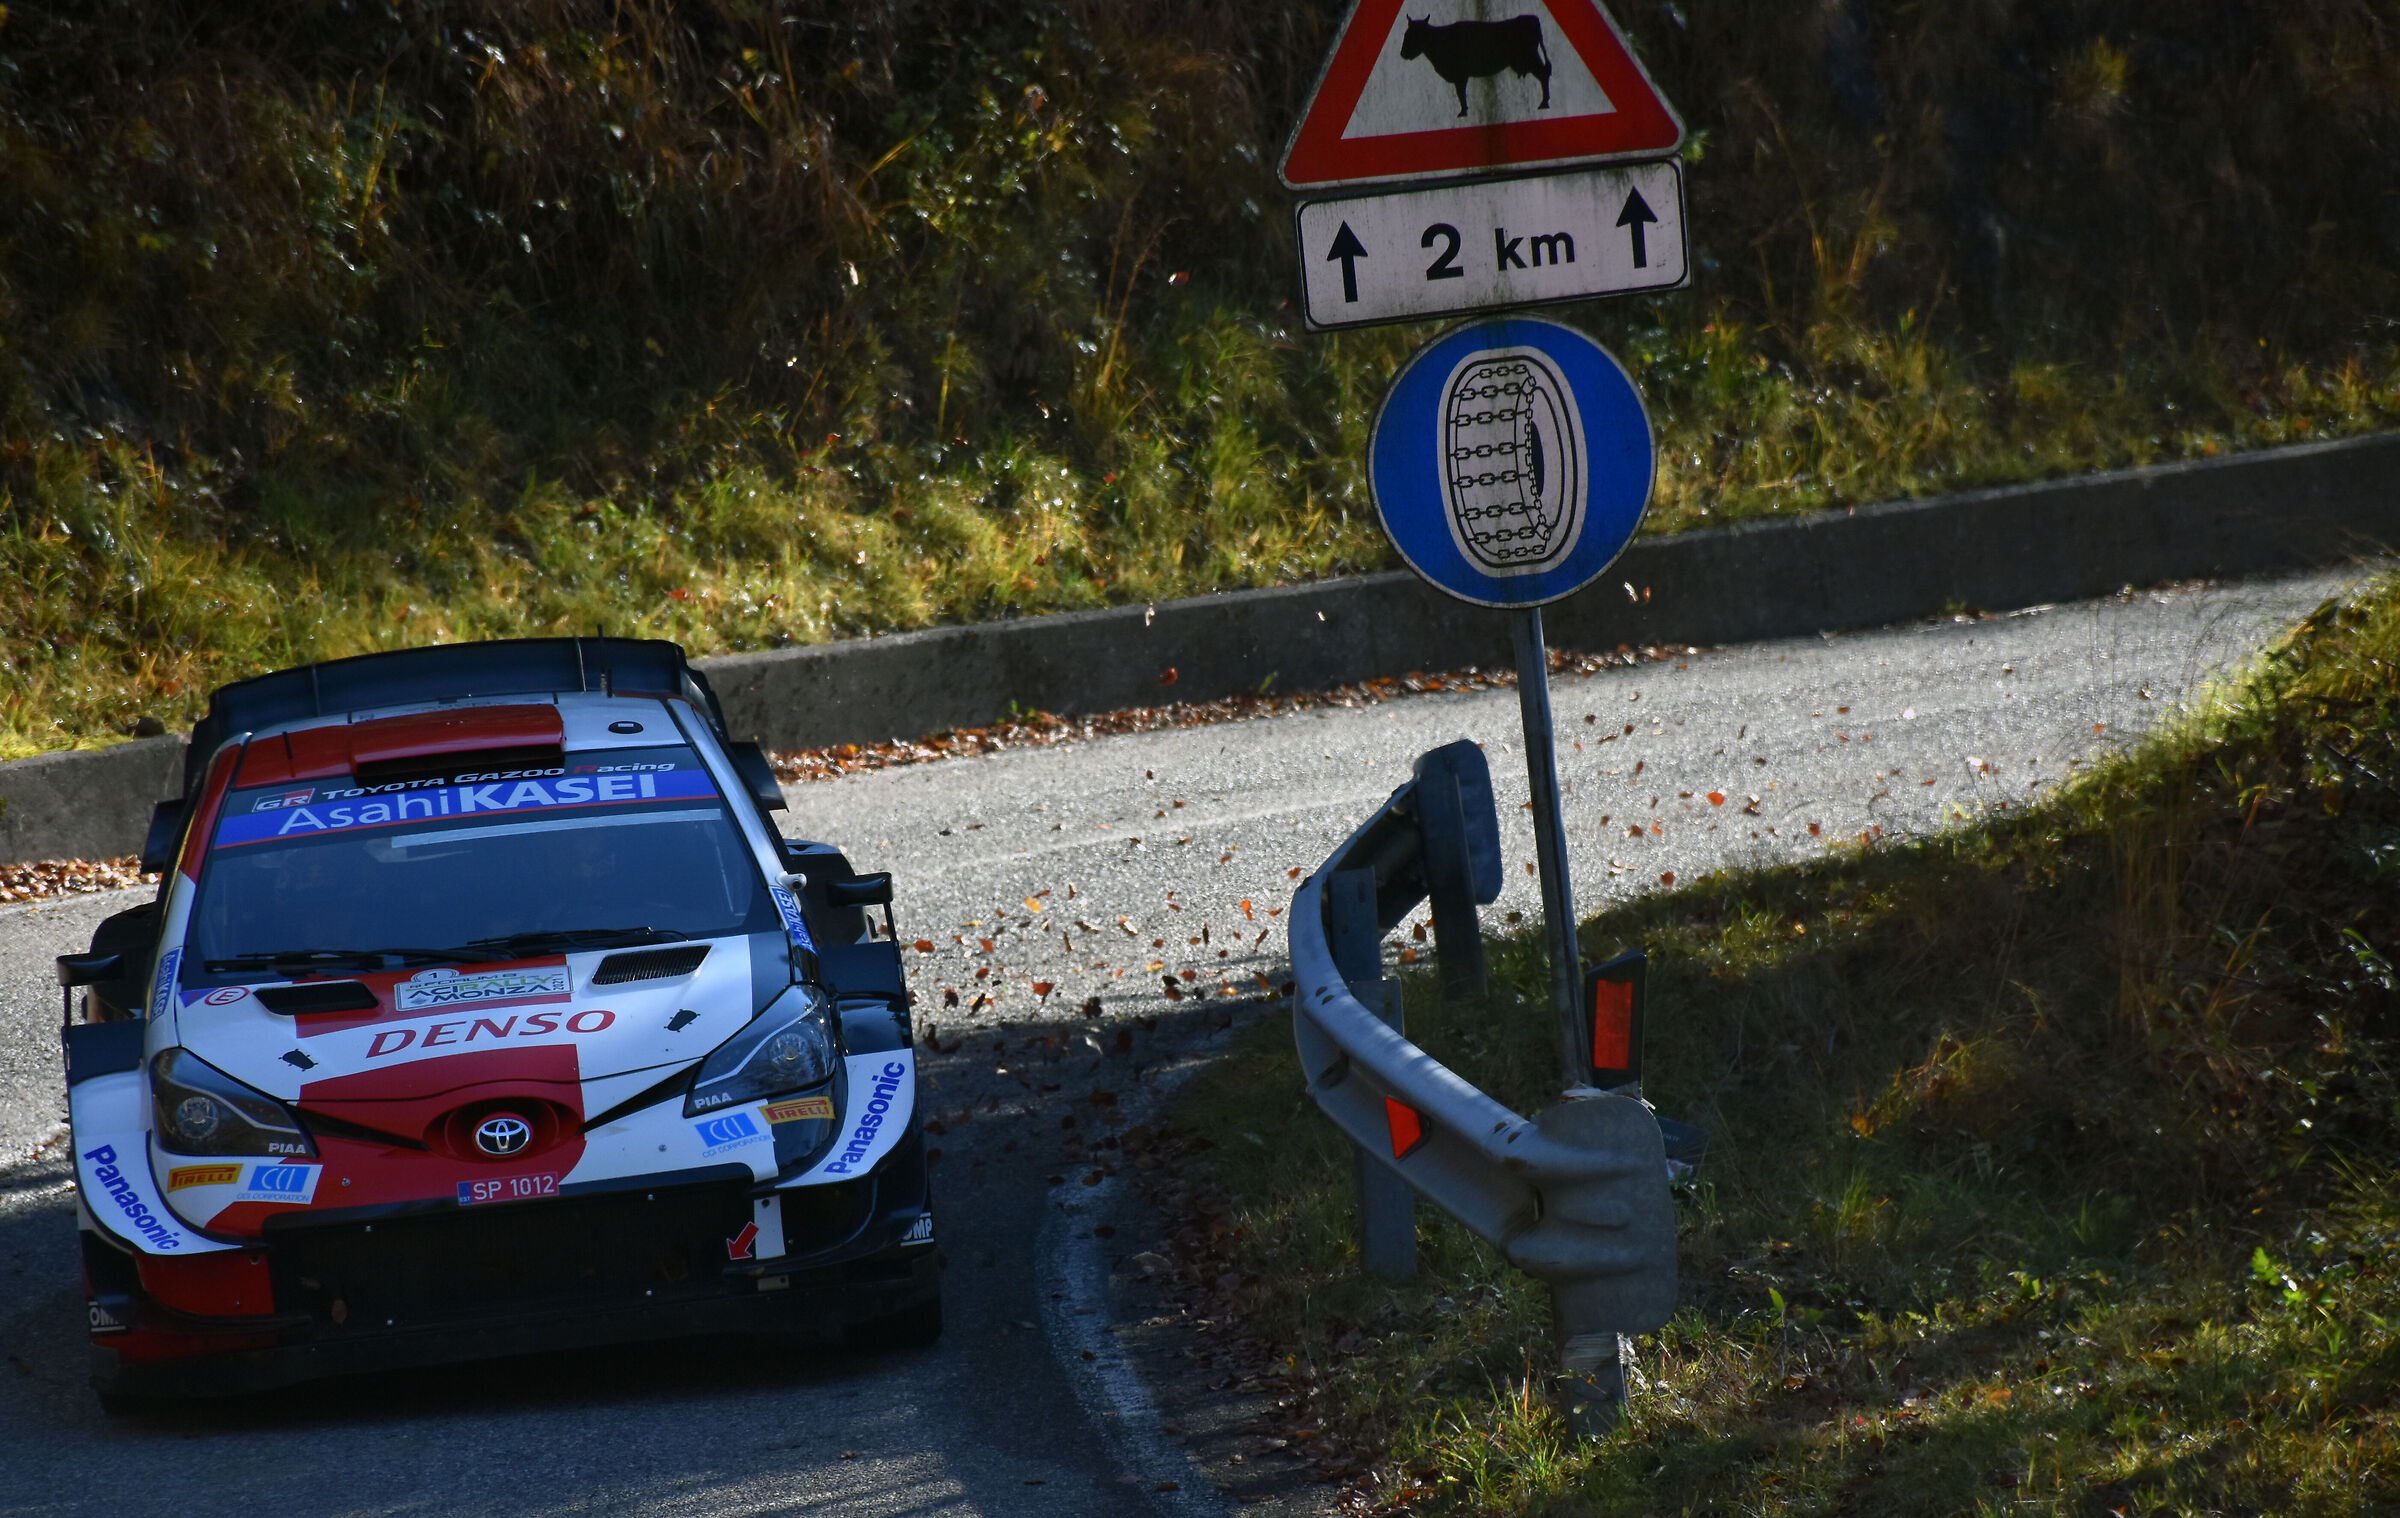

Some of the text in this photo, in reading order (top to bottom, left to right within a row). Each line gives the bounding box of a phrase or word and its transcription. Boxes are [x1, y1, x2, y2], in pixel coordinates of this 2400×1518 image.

[1421, 223, 1576, 281] 2 km
[255, 762, 676, 811] GR TOYOTA GAZOO Racing
[215, 991, 240, 1002] E
[432, 984, 551, 1003] MONZA
[366, 1010, 616, 1059] DENSO
[695, 1092, 733, 1109] PIAA
[765, 1099, 830, 1121] PIRELLI
[824, 1062, 905, 1174] Panasonic
[268, 1142, 307, 1154] PIAA
[170, 1166, 238, 1189] PIRELLI
[473, 1175, 555, 1201] SP 1012
[83, 1144, 180, 1250] Panasonic
[90, 1306, 120, 1326] OM
